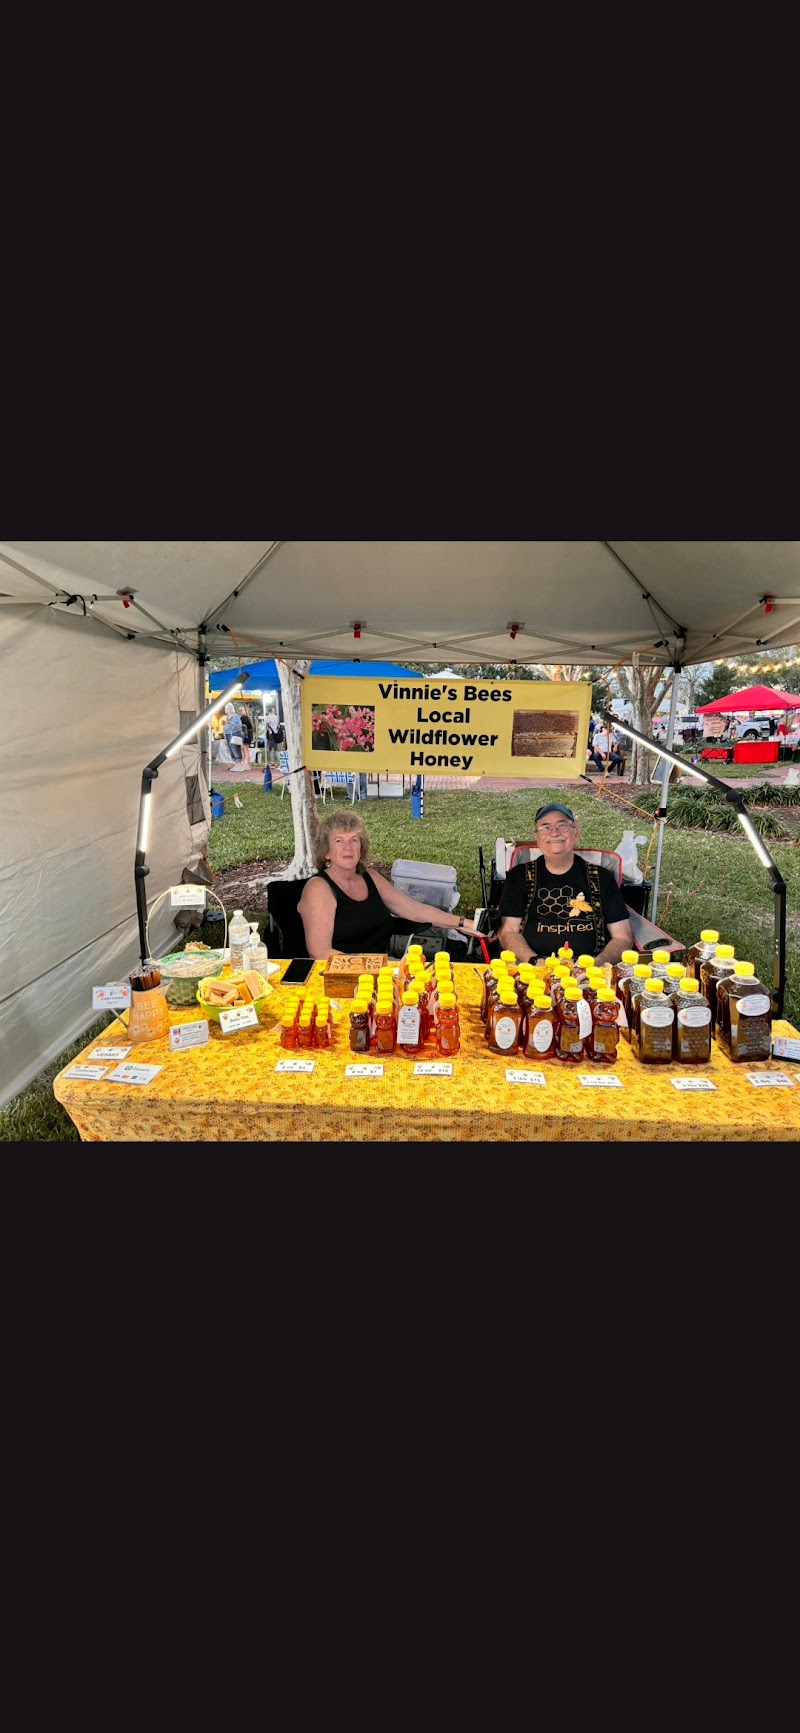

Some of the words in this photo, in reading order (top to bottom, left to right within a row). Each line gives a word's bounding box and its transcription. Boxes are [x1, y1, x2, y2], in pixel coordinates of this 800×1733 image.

[378, 683, 458, 701] Vinnie's
[464, 685, 512, 702] Bees
[417, 707, 470, 723] Local
[388, 729, 499, 746] Wildflower
[410, 751, 474, 770] Honey
[537, 921, 594, 935] inspired
[136, 999, 158, 1011] BEE
[132, 1006, 164, 1021] HAPPY
